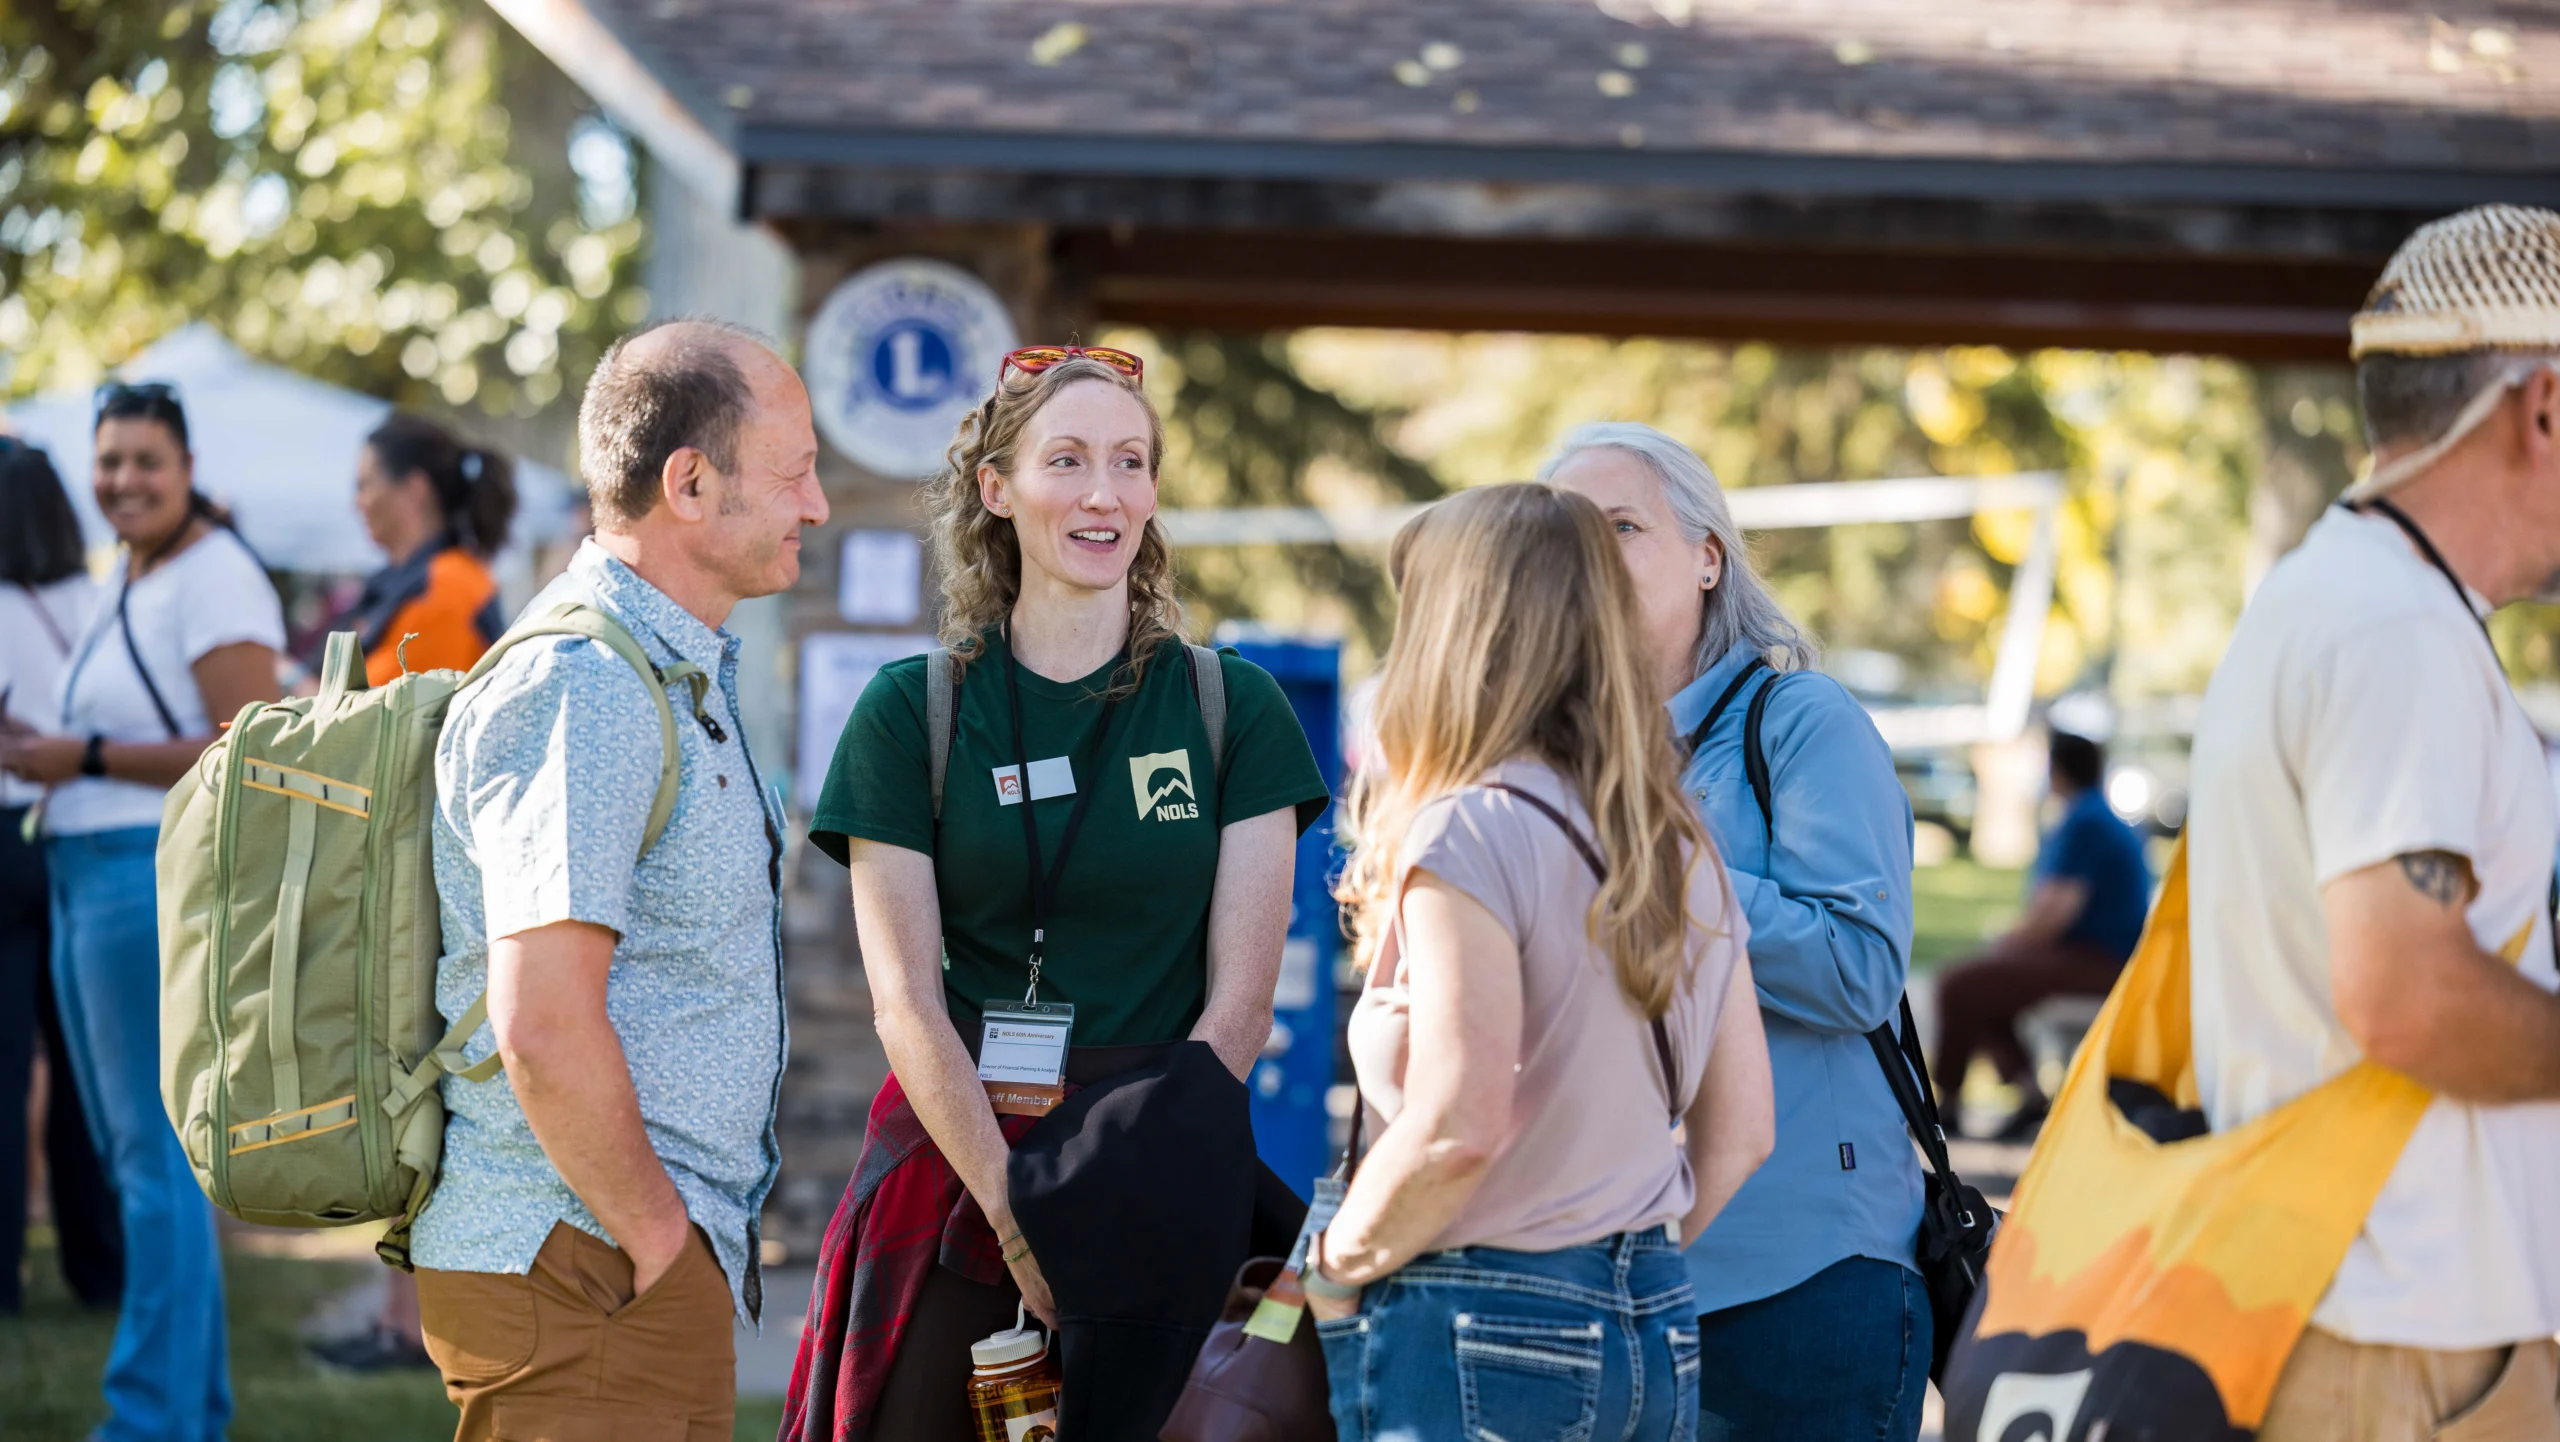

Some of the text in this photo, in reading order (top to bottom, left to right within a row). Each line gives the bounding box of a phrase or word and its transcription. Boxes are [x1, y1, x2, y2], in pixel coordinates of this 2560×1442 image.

[891, 328, 942, 398] L
[1156, 803, 1199, 822] NOLS
[987, 1092, 1054, 1106] aff Member
